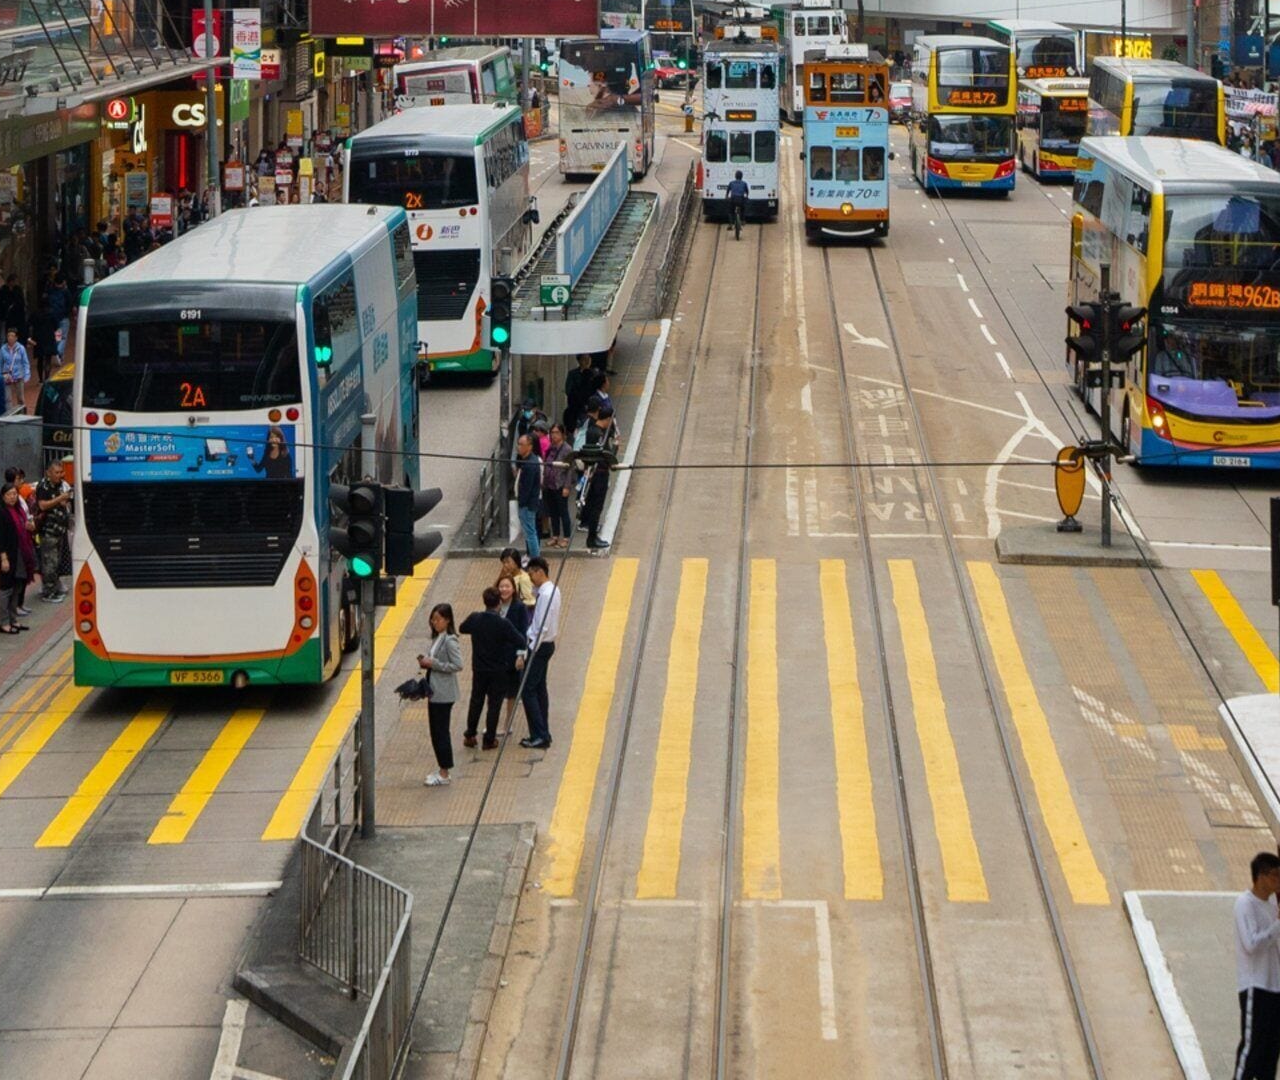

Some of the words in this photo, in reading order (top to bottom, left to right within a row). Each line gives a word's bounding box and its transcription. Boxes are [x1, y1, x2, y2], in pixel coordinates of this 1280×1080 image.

[982, 92, 997, 105] 72
[180, 309, 202, 320] 6191
[179, 382, 206, 407] 2A
[125, 443, 176, 453] MasterSoft
[175, 671, 187, 682] VF
[193, 671, 221, 682] 5366
